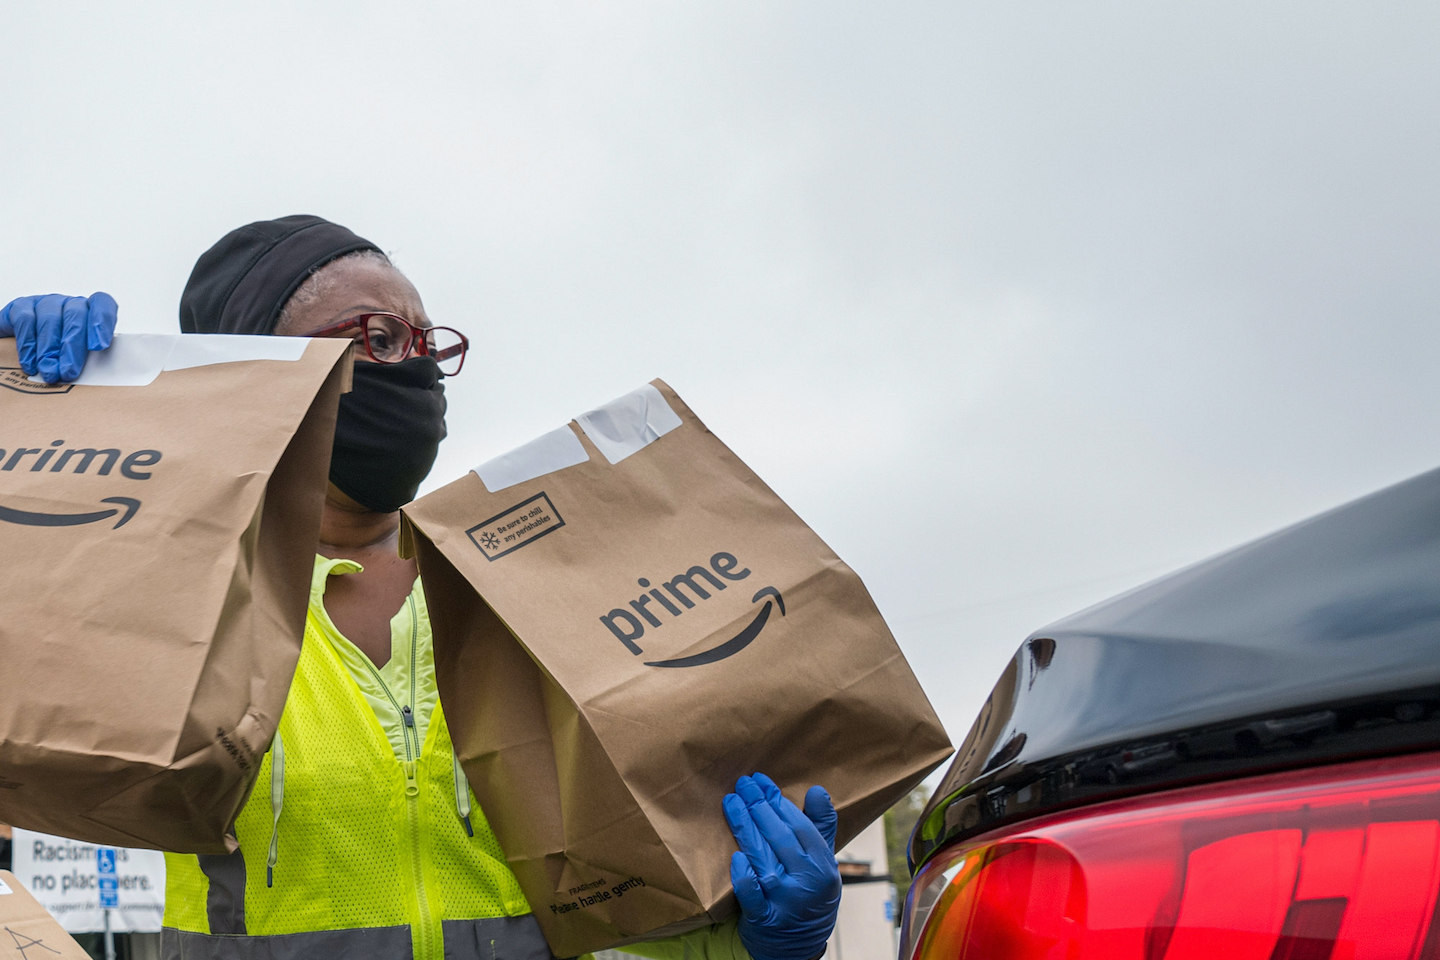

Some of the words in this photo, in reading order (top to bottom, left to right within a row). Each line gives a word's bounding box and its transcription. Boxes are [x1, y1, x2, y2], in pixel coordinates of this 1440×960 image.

[497, 526, 506, 534] Be
[507, 519, 521, 530] sure
[520, 515, 528, 523] to
[529, 506, 543, 518] chill
[504, 534, 516, 543] any
[516, 514, 551, 538] perishables
[599, 551, 751, 656] prime
[32, 874, 56, 890] no
[61, 869, 98, 894] plac
[612, 876, 646, 897] gently
